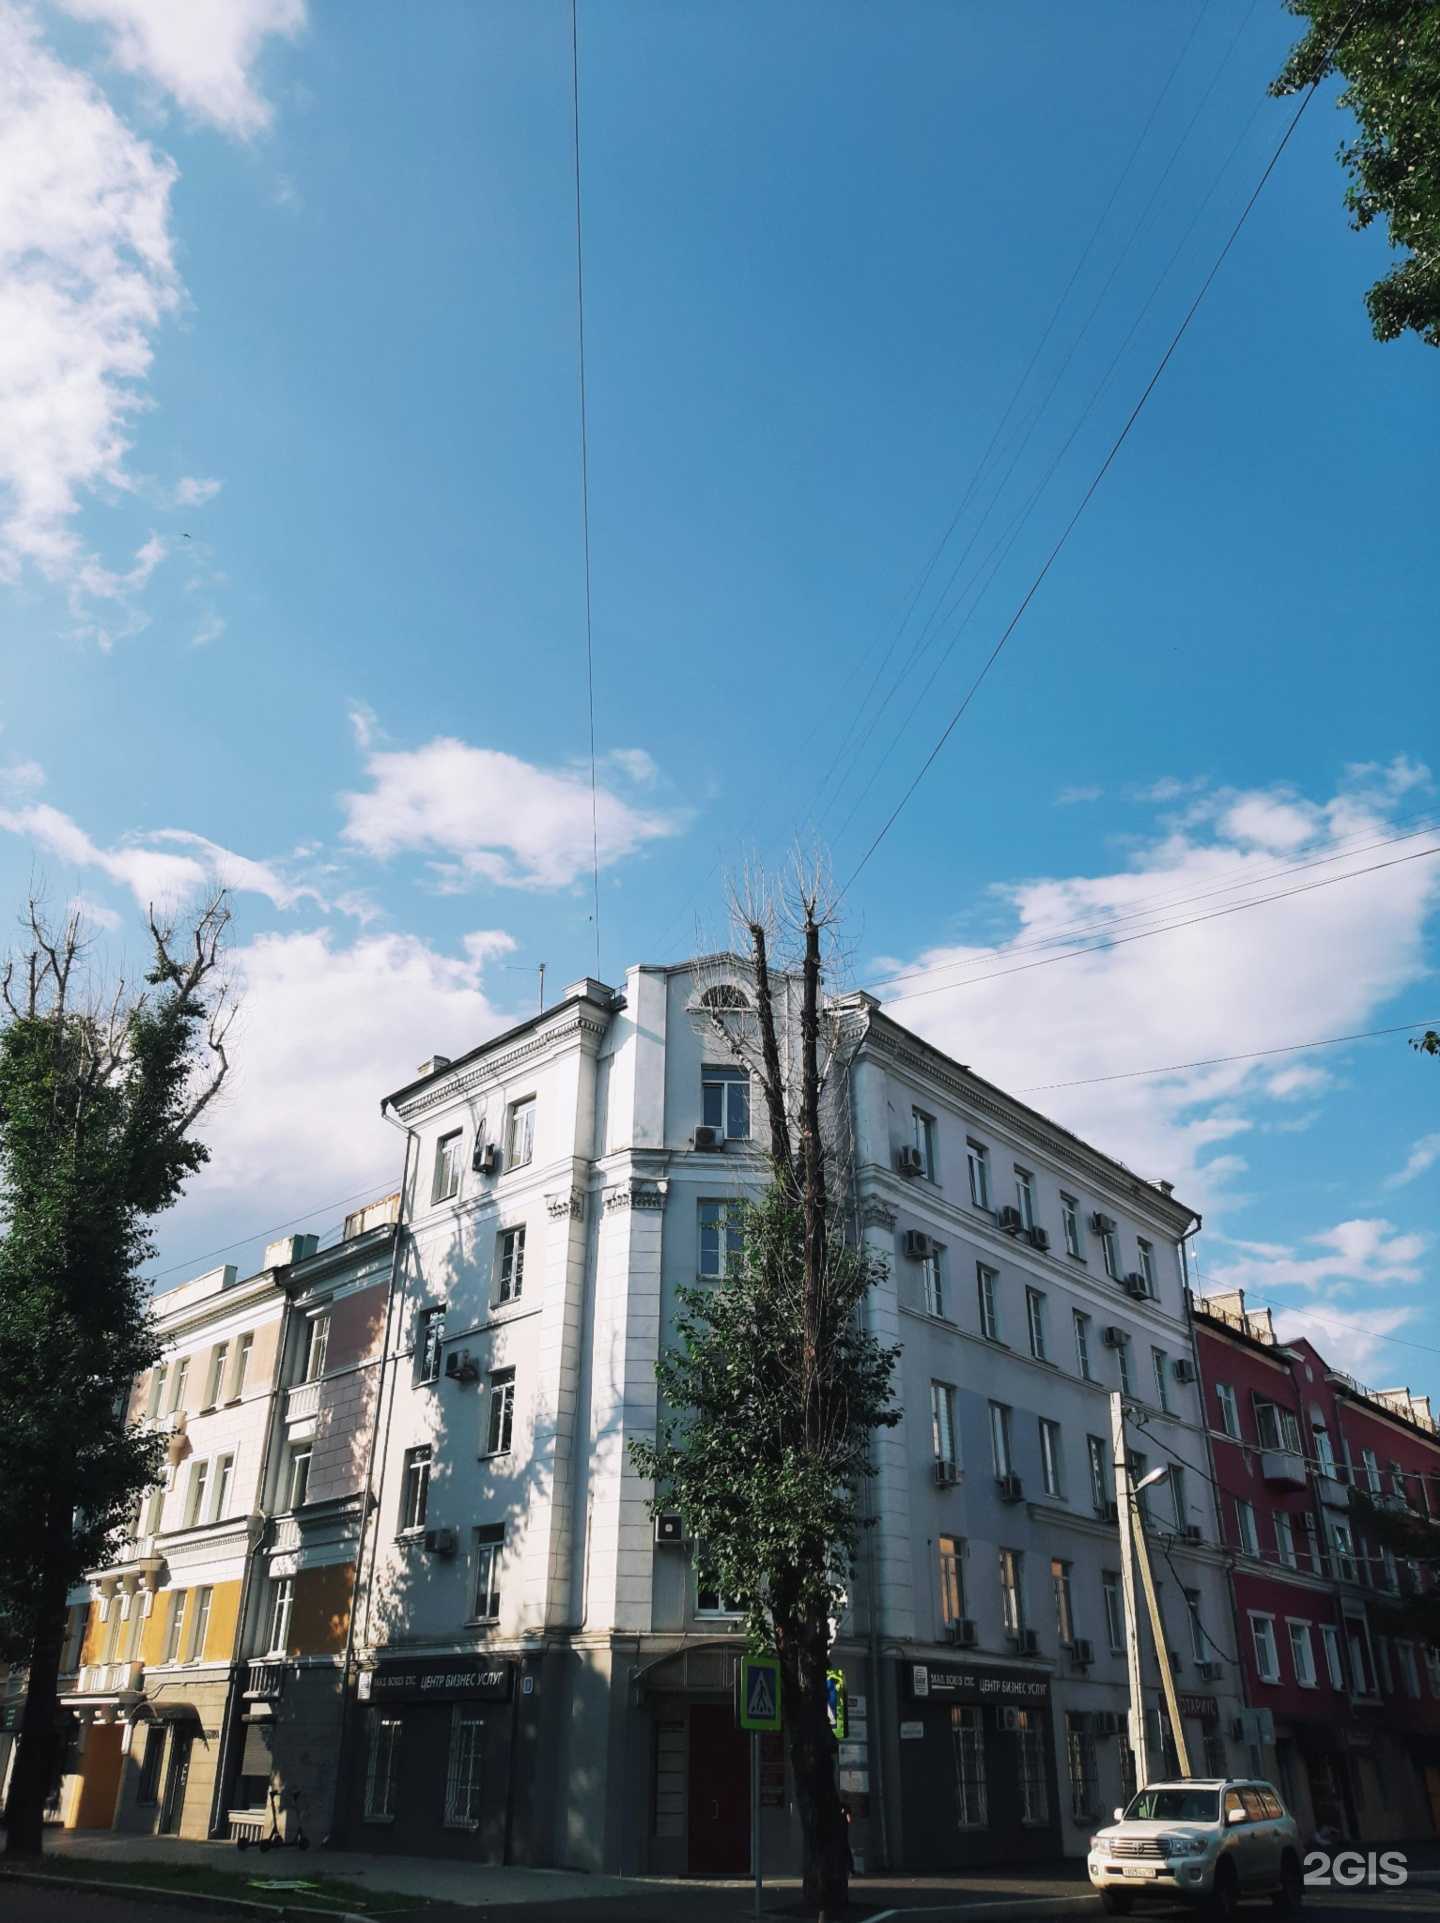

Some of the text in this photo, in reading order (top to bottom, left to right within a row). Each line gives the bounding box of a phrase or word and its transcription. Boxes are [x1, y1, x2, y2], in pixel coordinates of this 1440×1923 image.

[421, 1674, 445, 1691] ЦЕНТР
[445, 1673, 476, 1687] БИЗНЕС
[476, 1671, 504, 1686] УСЛУГ
[980, 1679, 1047, 1696] ЦЕНТР БИЗНЕС УСЛУГ
